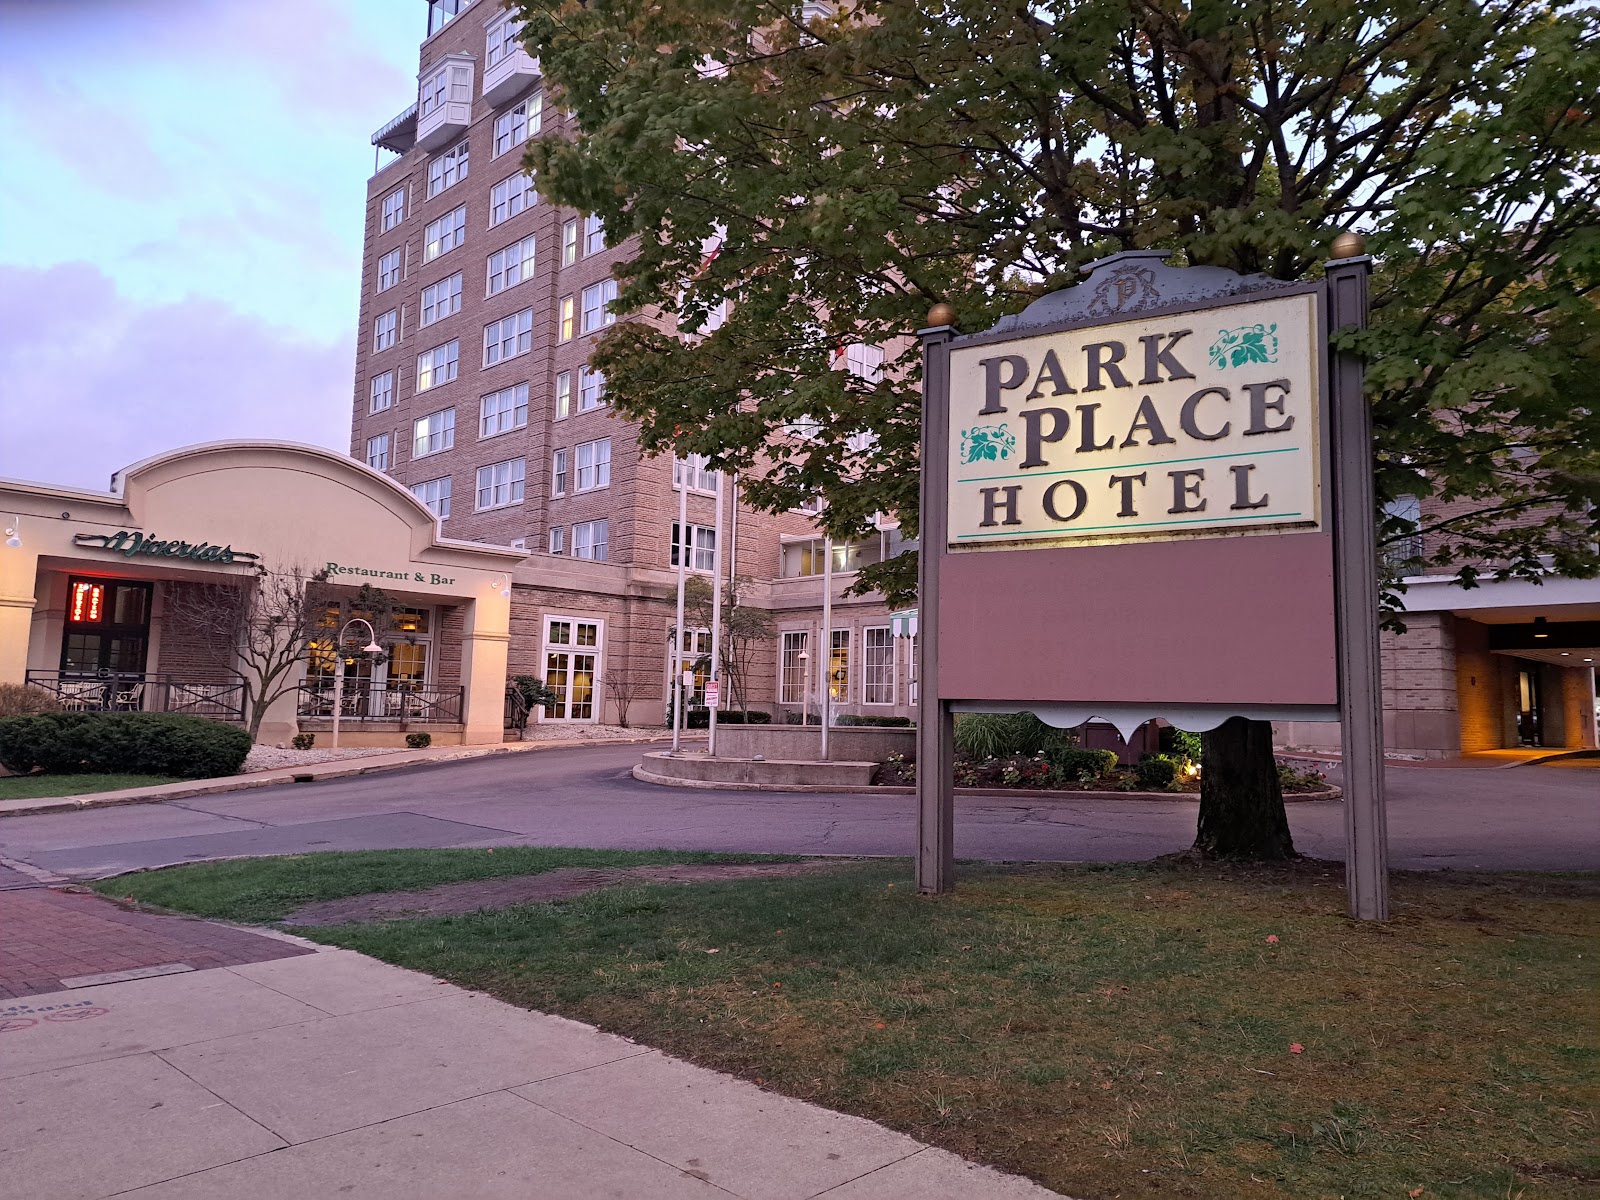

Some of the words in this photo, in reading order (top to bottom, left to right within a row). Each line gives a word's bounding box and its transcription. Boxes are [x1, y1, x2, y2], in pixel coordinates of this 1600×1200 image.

[979, 329, 1196, 416] PARK
[1018, 378, 1295, 470] PLACE
[979, 464, 1269, 527] HOTEL
[325, 562, 409, 580] Restaurant
[414, 572, 426, 582] &
[429, 573, 456, 585] Bar
